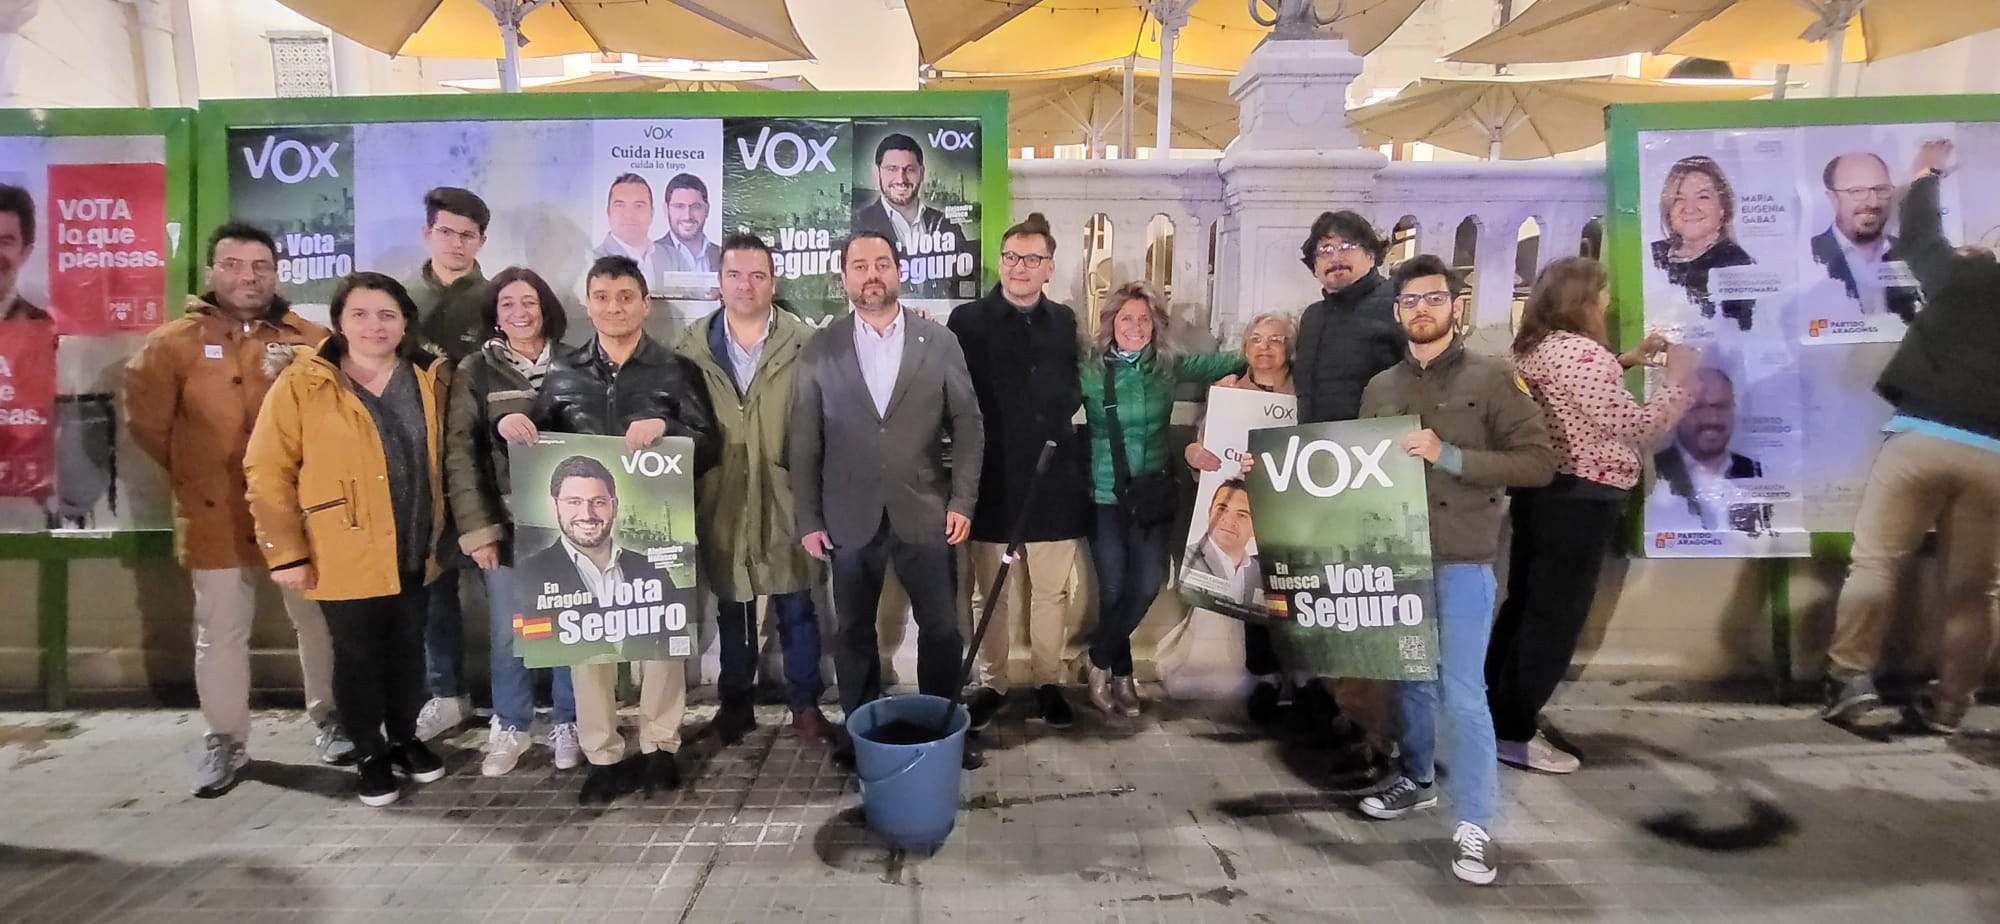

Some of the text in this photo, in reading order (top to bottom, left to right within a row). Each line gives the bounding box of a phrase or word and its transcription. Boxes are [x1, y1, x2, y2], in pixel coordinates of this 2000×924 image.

[643, 125, 674, 141] VOX
[928, 128, 975, 151] VOX
[243, 135, 340, 184] VOX
[611, 146, 705, 160] Cuida Huesca
[737, 126, 839, 177] VOX
[630, 161, 686, 172] cuida lo tuyo
[58, 199, 131, 221] VOTA
[59, 223, 135, 248] lo que
[286, 233, 335, 257] Vota
[779, 227, 830, 251] Vota
[904, 231, 956, 256] Vota
[59, 247, 165, 272] piensas.
[277, 254, 351, 285] eguro
[900, 252, 974, 285] eguro
[1263, 403, 1296, 420] VOX
[621, 449, 683, 477] VOX
[1261, 435, 1394, 498] VOX
[1269, 563, 1394, 594] Huesca Vota
[1276, 562, 1289, 576] En
[537, 578, 663, 610] Aragón Vota
[544, 582, 559, 595] En
[558, 603, 687, 645] Seguro
[1294, 592, 1424, 632] Seguro
